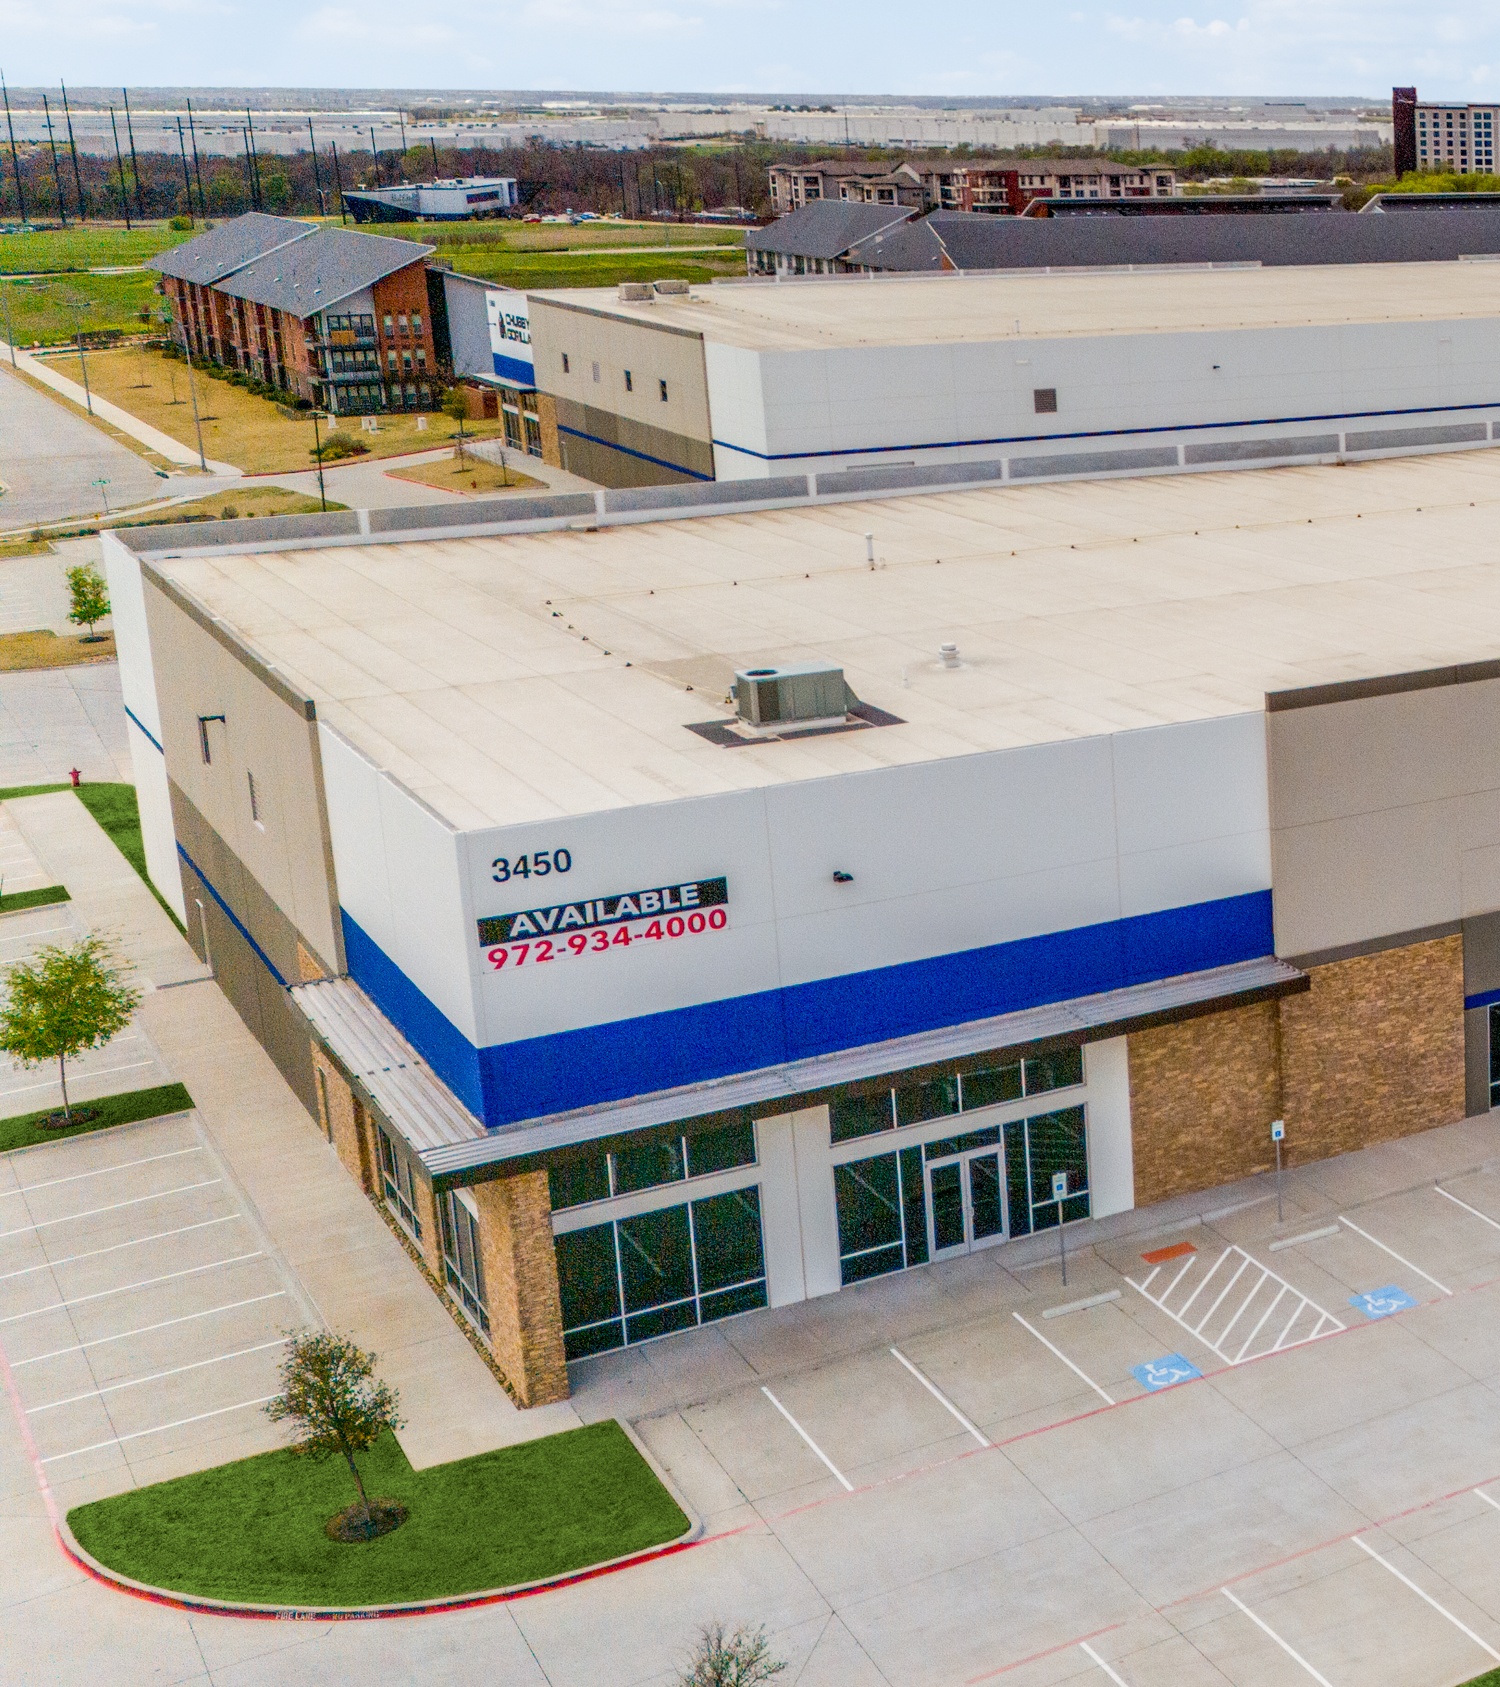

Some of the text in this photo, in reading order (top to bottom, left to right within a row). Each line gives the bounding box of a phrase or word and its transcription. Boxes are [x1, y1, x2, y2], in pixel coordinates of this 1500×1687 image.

[491, 848, 572, 883] 3450
[509, 884, 700, 938] AVAILABLE
[487, 909, 728, 970] 972-934-4000
[275, 1610, 294, 1620] FIRE
[295, 1610, 316, 1621] LANE
[345, 1610, 380, 1620] PARKING
